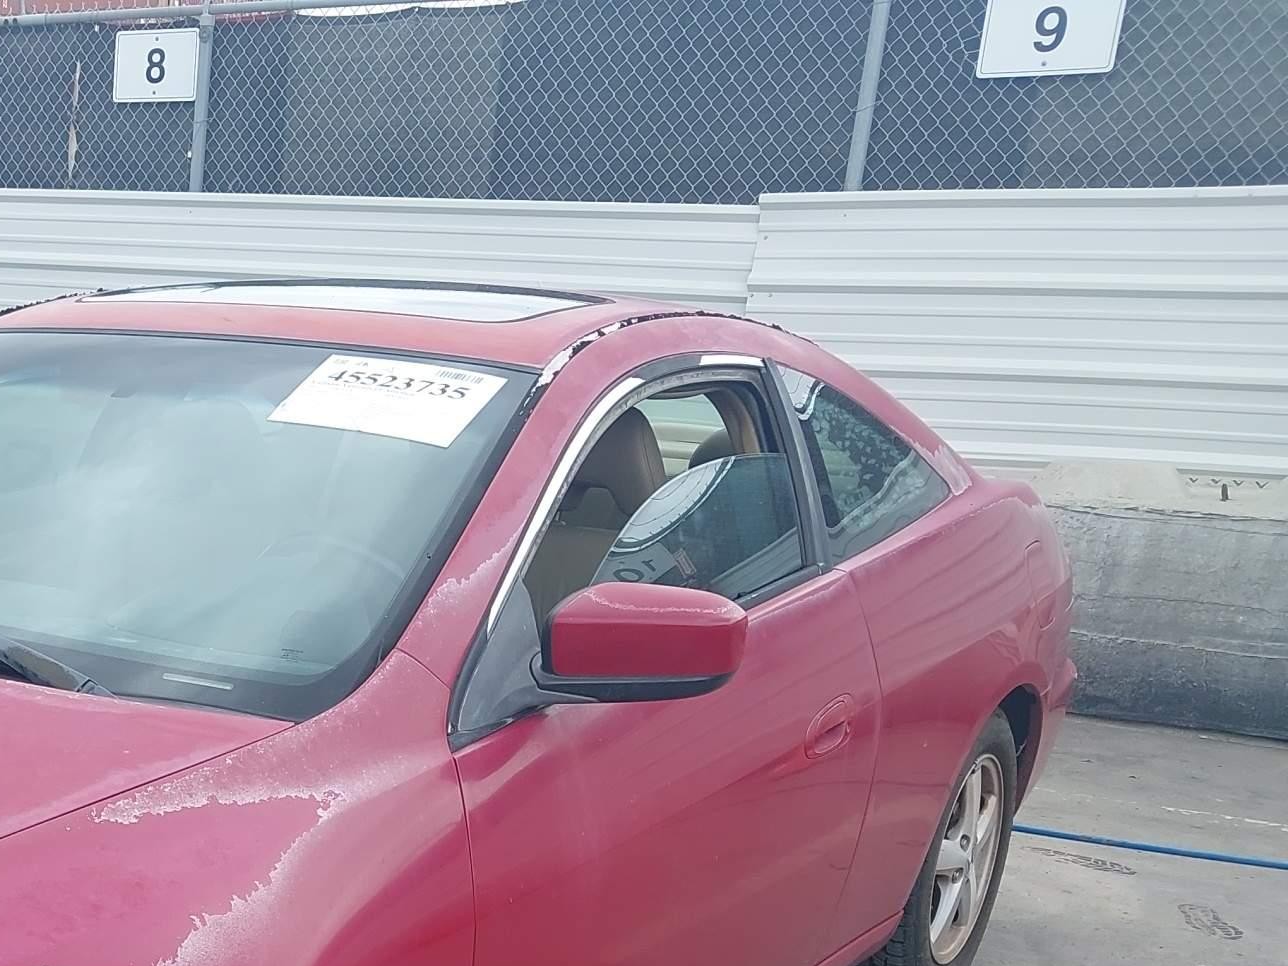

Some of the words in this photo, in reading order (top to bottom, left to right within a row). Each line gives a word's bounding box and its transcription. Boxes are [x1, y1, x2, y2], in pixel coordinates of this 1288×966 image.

[1033, 6, 1067, 53] 9
[145, 47, 166, 84] 8
[328, 370, 471, 400] 45523735
